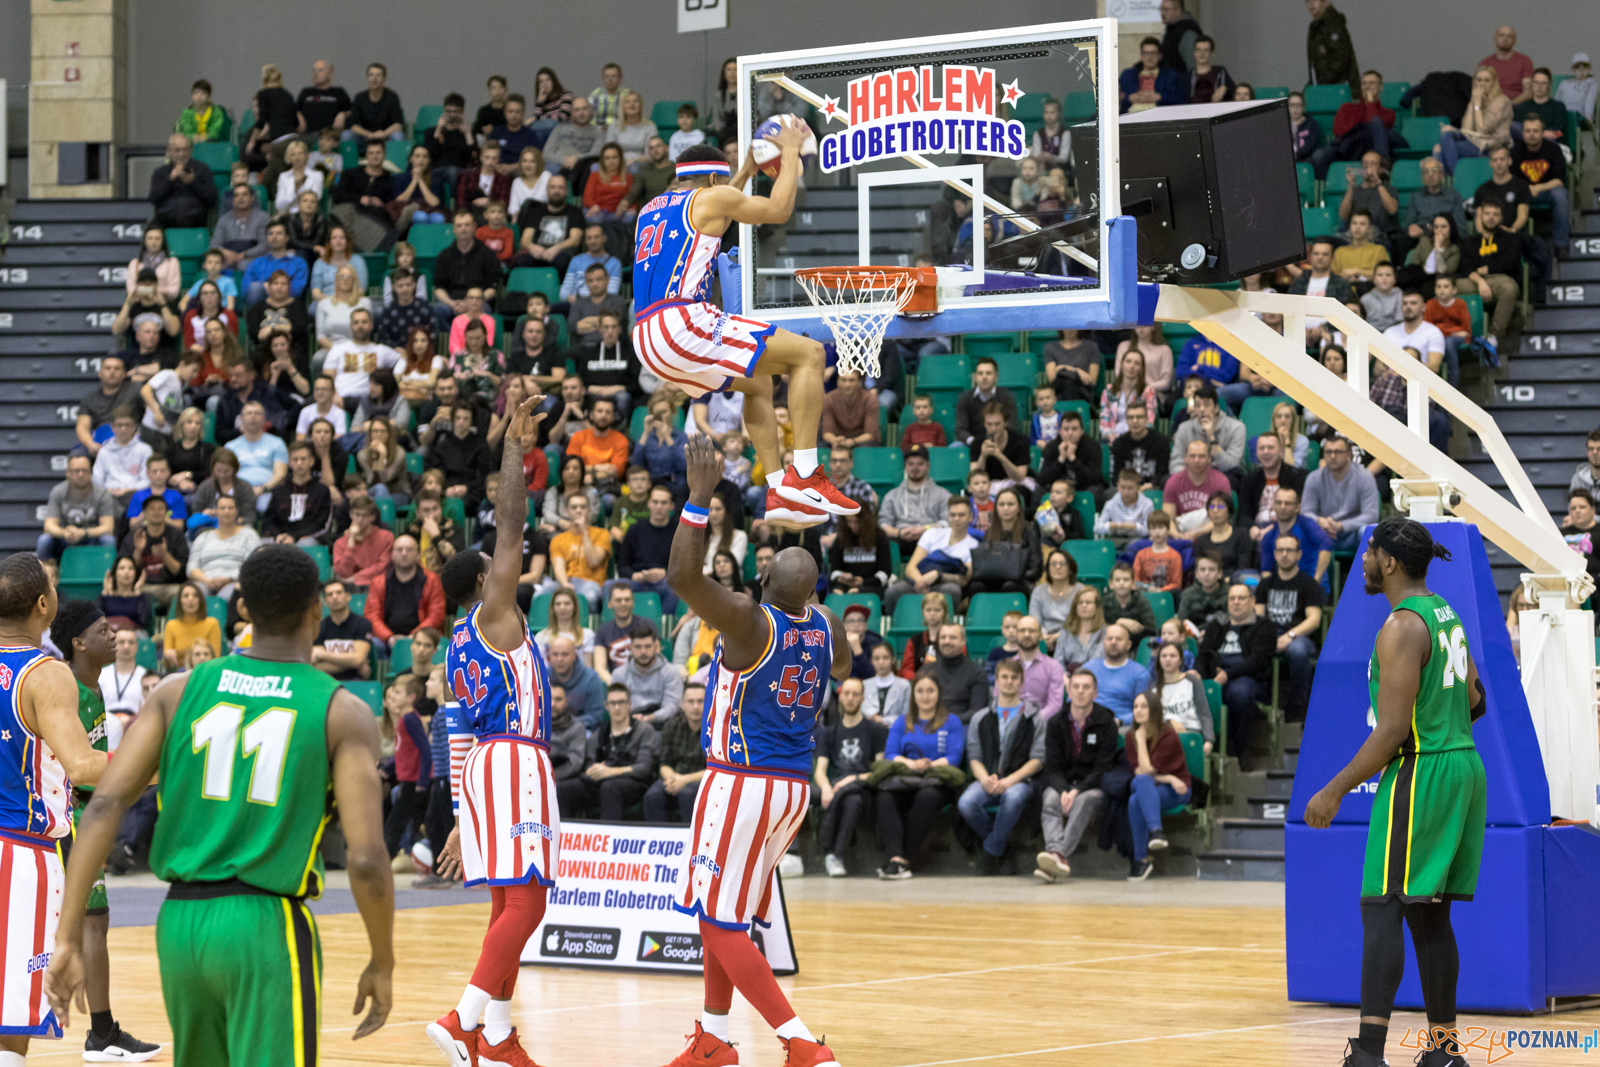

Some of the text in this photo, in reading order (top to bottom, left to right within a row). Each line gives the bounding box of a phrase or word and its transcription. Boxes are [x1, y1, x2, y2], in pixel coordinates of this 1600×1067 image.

[850, 68, 994, 126] HARLEM
[822, 118, 1023, 170] GLOBETROTTERS
[13, 226, 42, 240] 14
[112, 224, 143, 238] 14
[636, 220, 667, 264] 21
[1575, 239, 1600, 254] 13
[0, 269, 27, 283] 13
[98, 268, 128, 282] 13
[1551, 286, 1584, 301] 12
[86, 313, 117, 327] 12
[1529, 335, 1557, 350] 11
[75, 358, 101, 372] 11
[1501, 386, 1535, 401] 10
[1438, 625, 1468, 689] 26
[217, 669, 293, 699] BURRELL
[454, 659, 488, 709] 42
[777, 665, 818, 708] 52
[191, 701, 298, 807] 11
[1263, 803, 1285, 819] 2
[510, 822, 552, 841] GLOBETROTTERS
[611, 838, 646, 856] your
[648, 840, 686, 857] expe
[549, 885, 675, 910] Harlem Globetrot
[564, 930, 592, 939] Download
[665, 936, 692, 944] GET IT ON
[561, 938, 613, 955] App Store
[663, 944, 698, 961] Google
